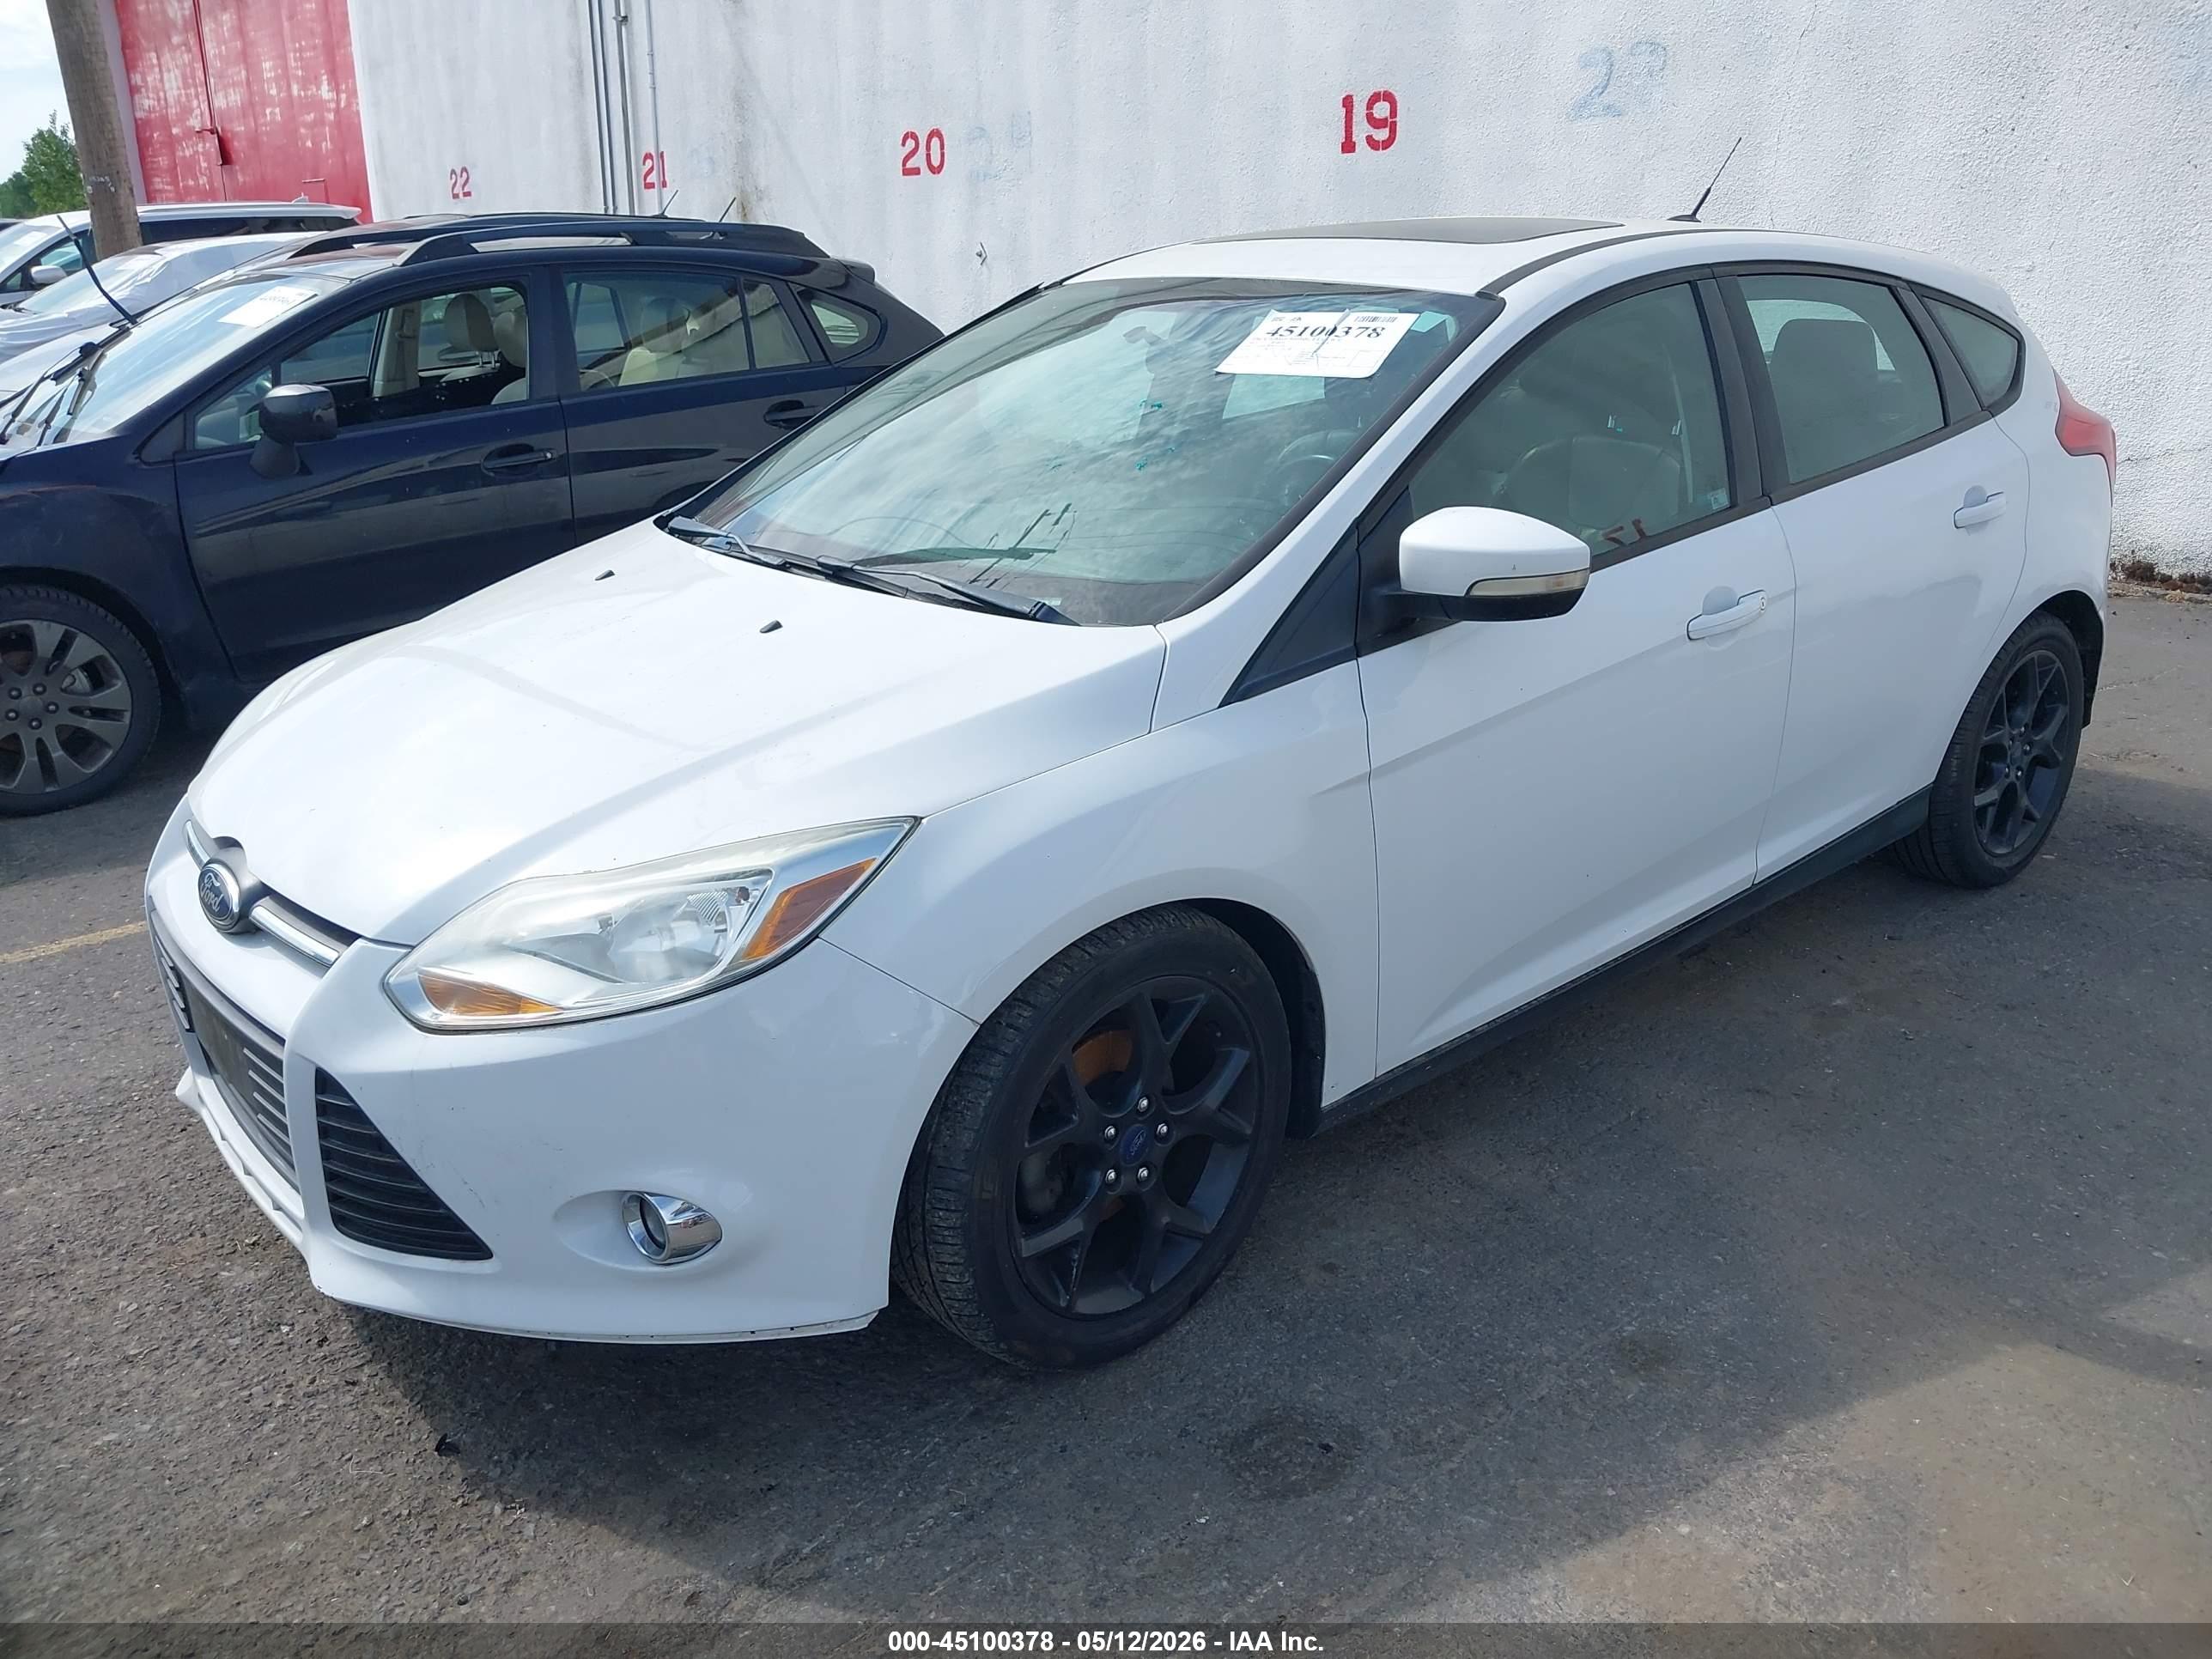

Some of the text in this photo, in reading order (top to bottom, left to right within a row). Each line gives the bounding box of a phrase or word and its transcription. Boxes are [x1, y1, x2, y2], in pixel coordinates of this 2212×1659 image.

[1340, 89, 1398, 154] 19
[642, 151, 667, 190] 21
[902, 128, 945, 176] 20
[449, 166, 471, 199] 22
[200, 872, 223, 912] Ford
